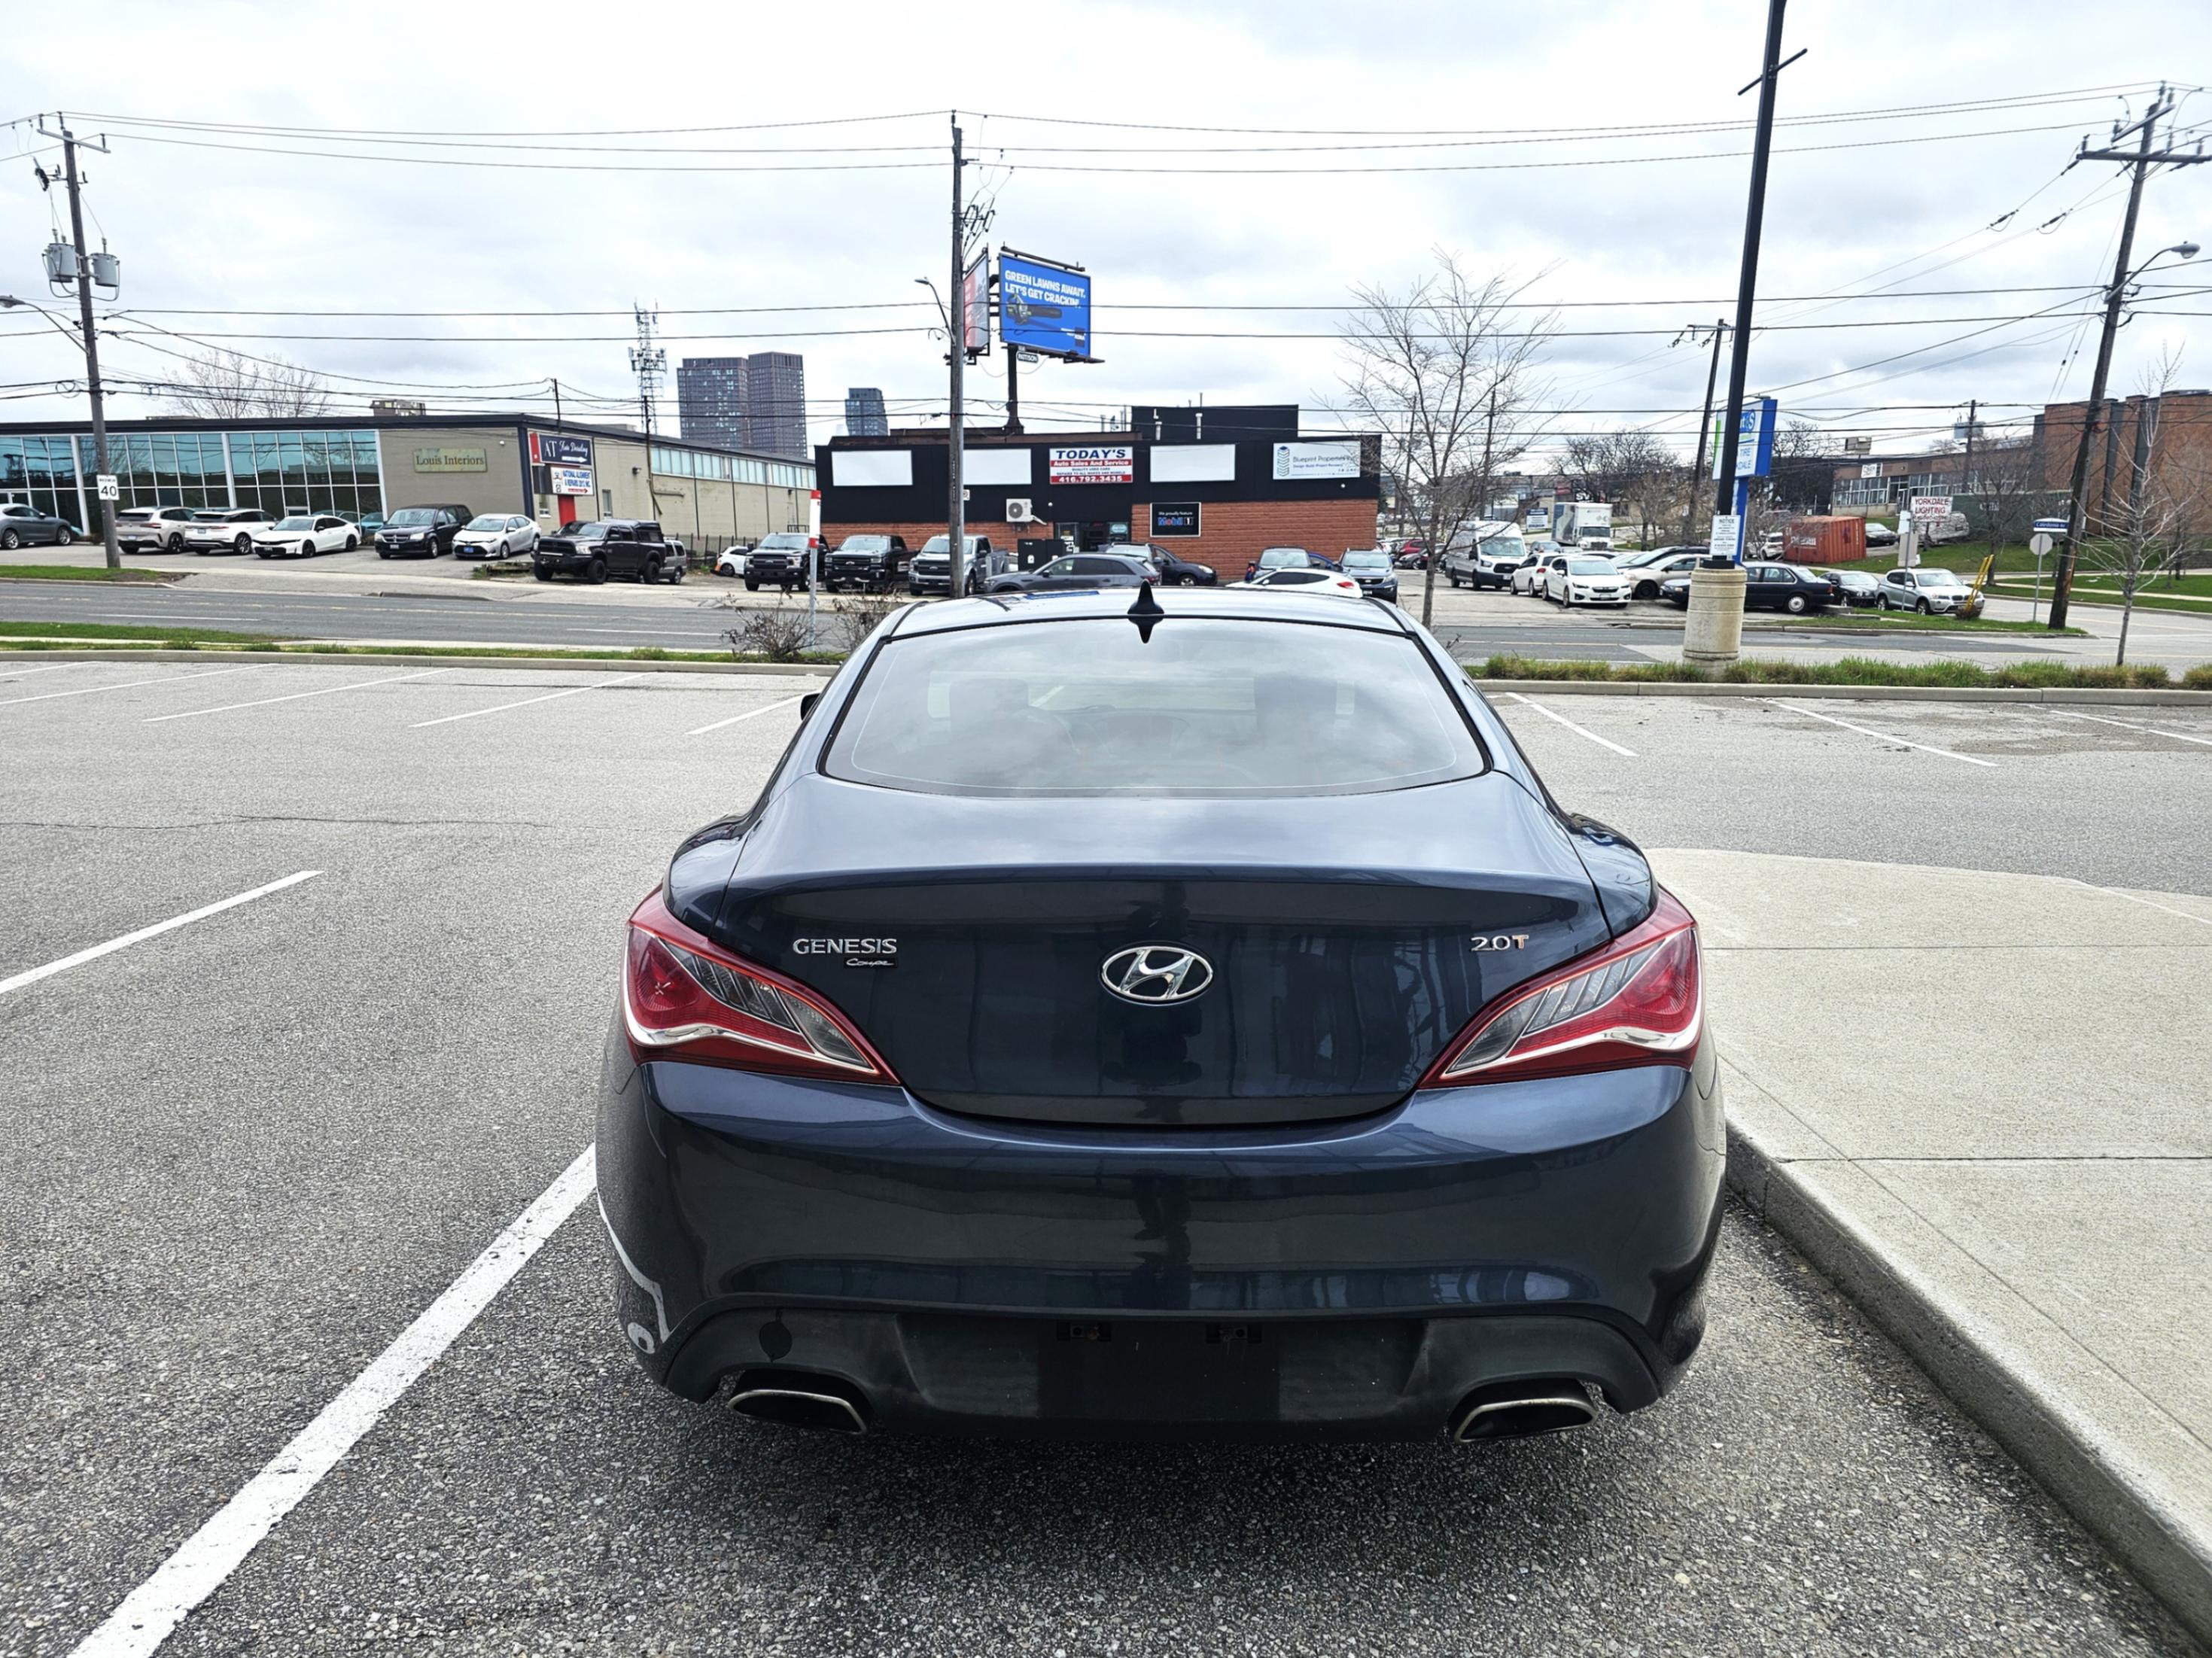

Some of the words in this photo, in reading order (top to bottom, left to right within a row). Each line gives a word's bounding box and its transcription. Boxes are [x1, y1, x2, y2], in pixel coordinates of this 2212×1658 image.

[1005, 270, 1032, 285] GREEN
[1032, 276, 1060, 292] LAWNS
[1061, 284, 1085, 299] AWAIT.
[1005, 282, 1027, 297] LET'S
[1027, 287, 1044, 300] GET
[544, 440, 558, 458] AT
[1056, 449, 1126, 459] TODAY'S
[416, 455, 443, 465] Louis
[444, 455, 485, 465] Interiors
[101, 485, 117, 497] 40
[1158, 517, 1183, 525] Mobil
[793, 939, 897, 954] GENESIS
[846, 958, 894, 967] Coupe
